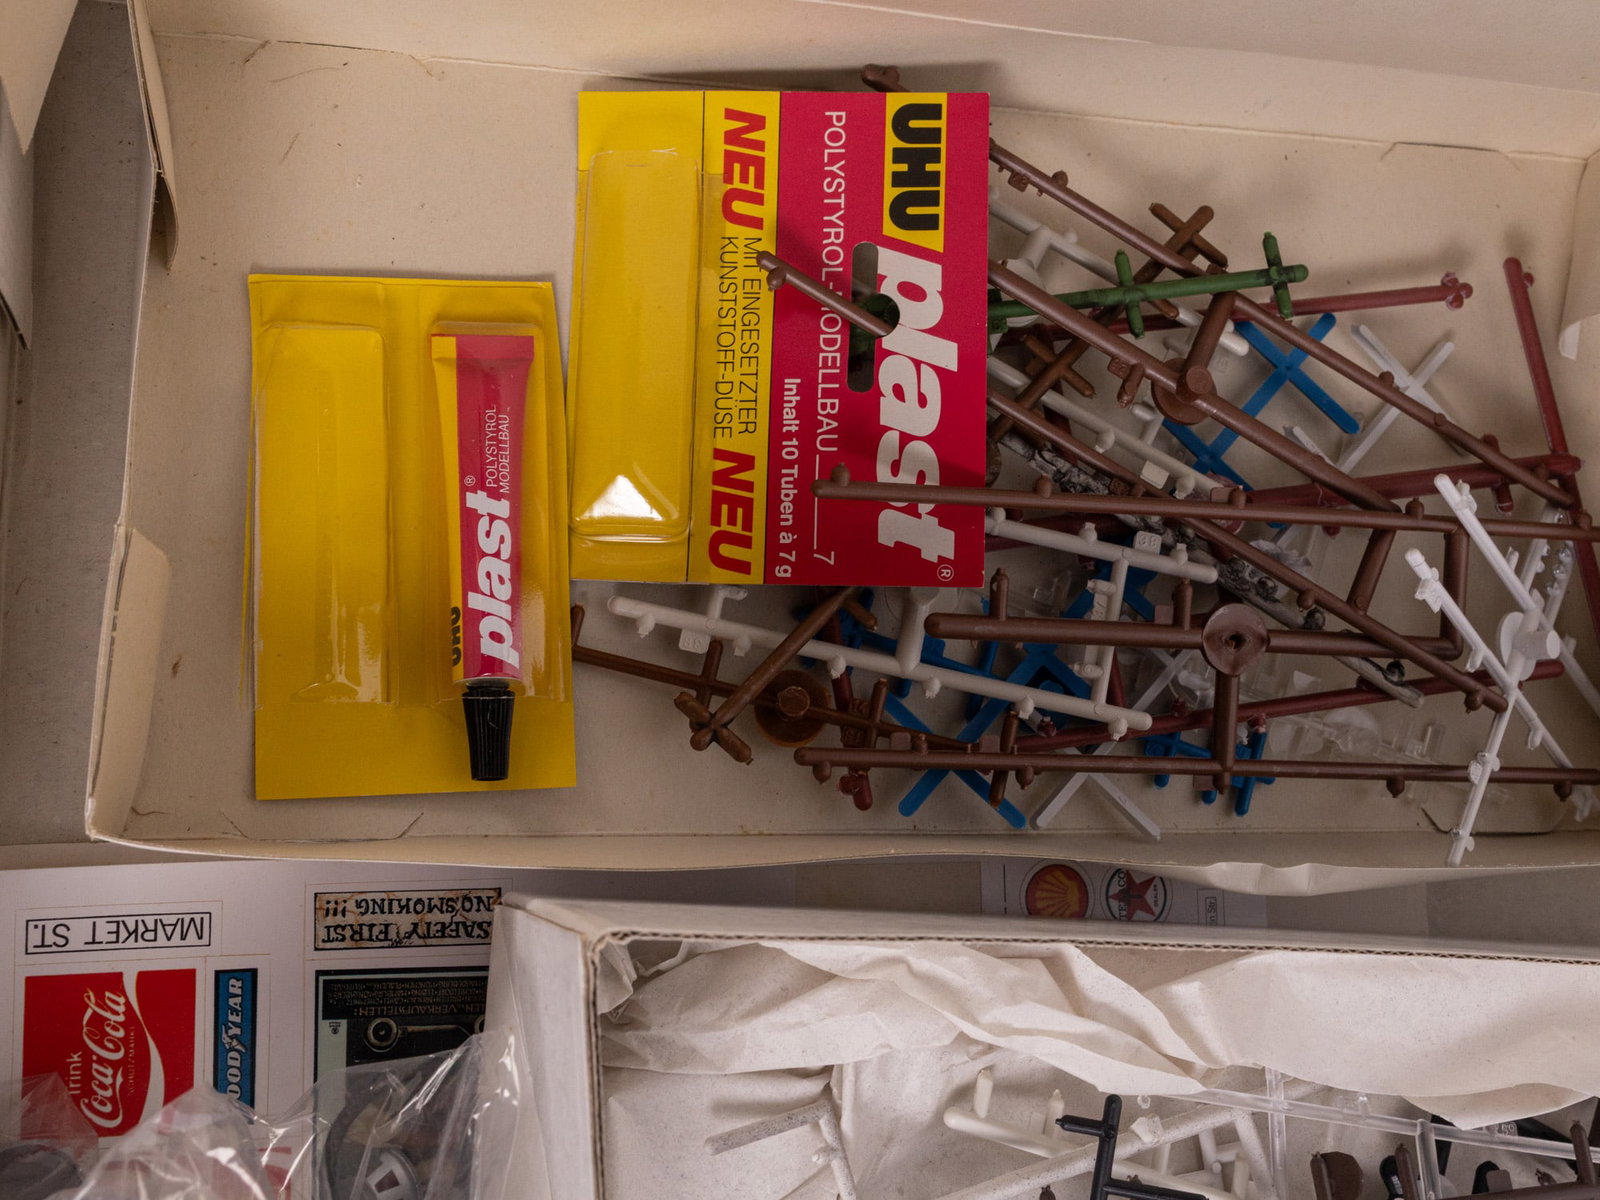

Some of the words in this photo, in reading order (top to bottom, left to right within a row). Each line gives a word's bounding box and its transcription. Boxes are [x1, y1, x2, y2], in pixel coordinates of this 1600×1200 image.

[722, 107, 767, 231] NEU
[889, 103, 942, 231] UHU
[742, 237, 763, 272] MIT
[713, 237, 739, 439] KUNSTSTOFF-DÜSE
[738, 278, 761, 434] EINGESETZTER
[782, 378, 801, 433] Inhalt
[485, 405, 498, 487] POLYSTYROL
[498, 414, 511, 494] MODELLBAU
[781, 440, 799, 460] 10
[708, 447, 756, 576] NEU
[780, 465, 798, 526] Tuben
[779, 532, 798, 544] à
[33, 923, 71, 948] ST.
[83, 917, 204, 945] MARKET
[321, 922, 395, 943] FIRST
[403, 920, 492, 940] SAFETY
